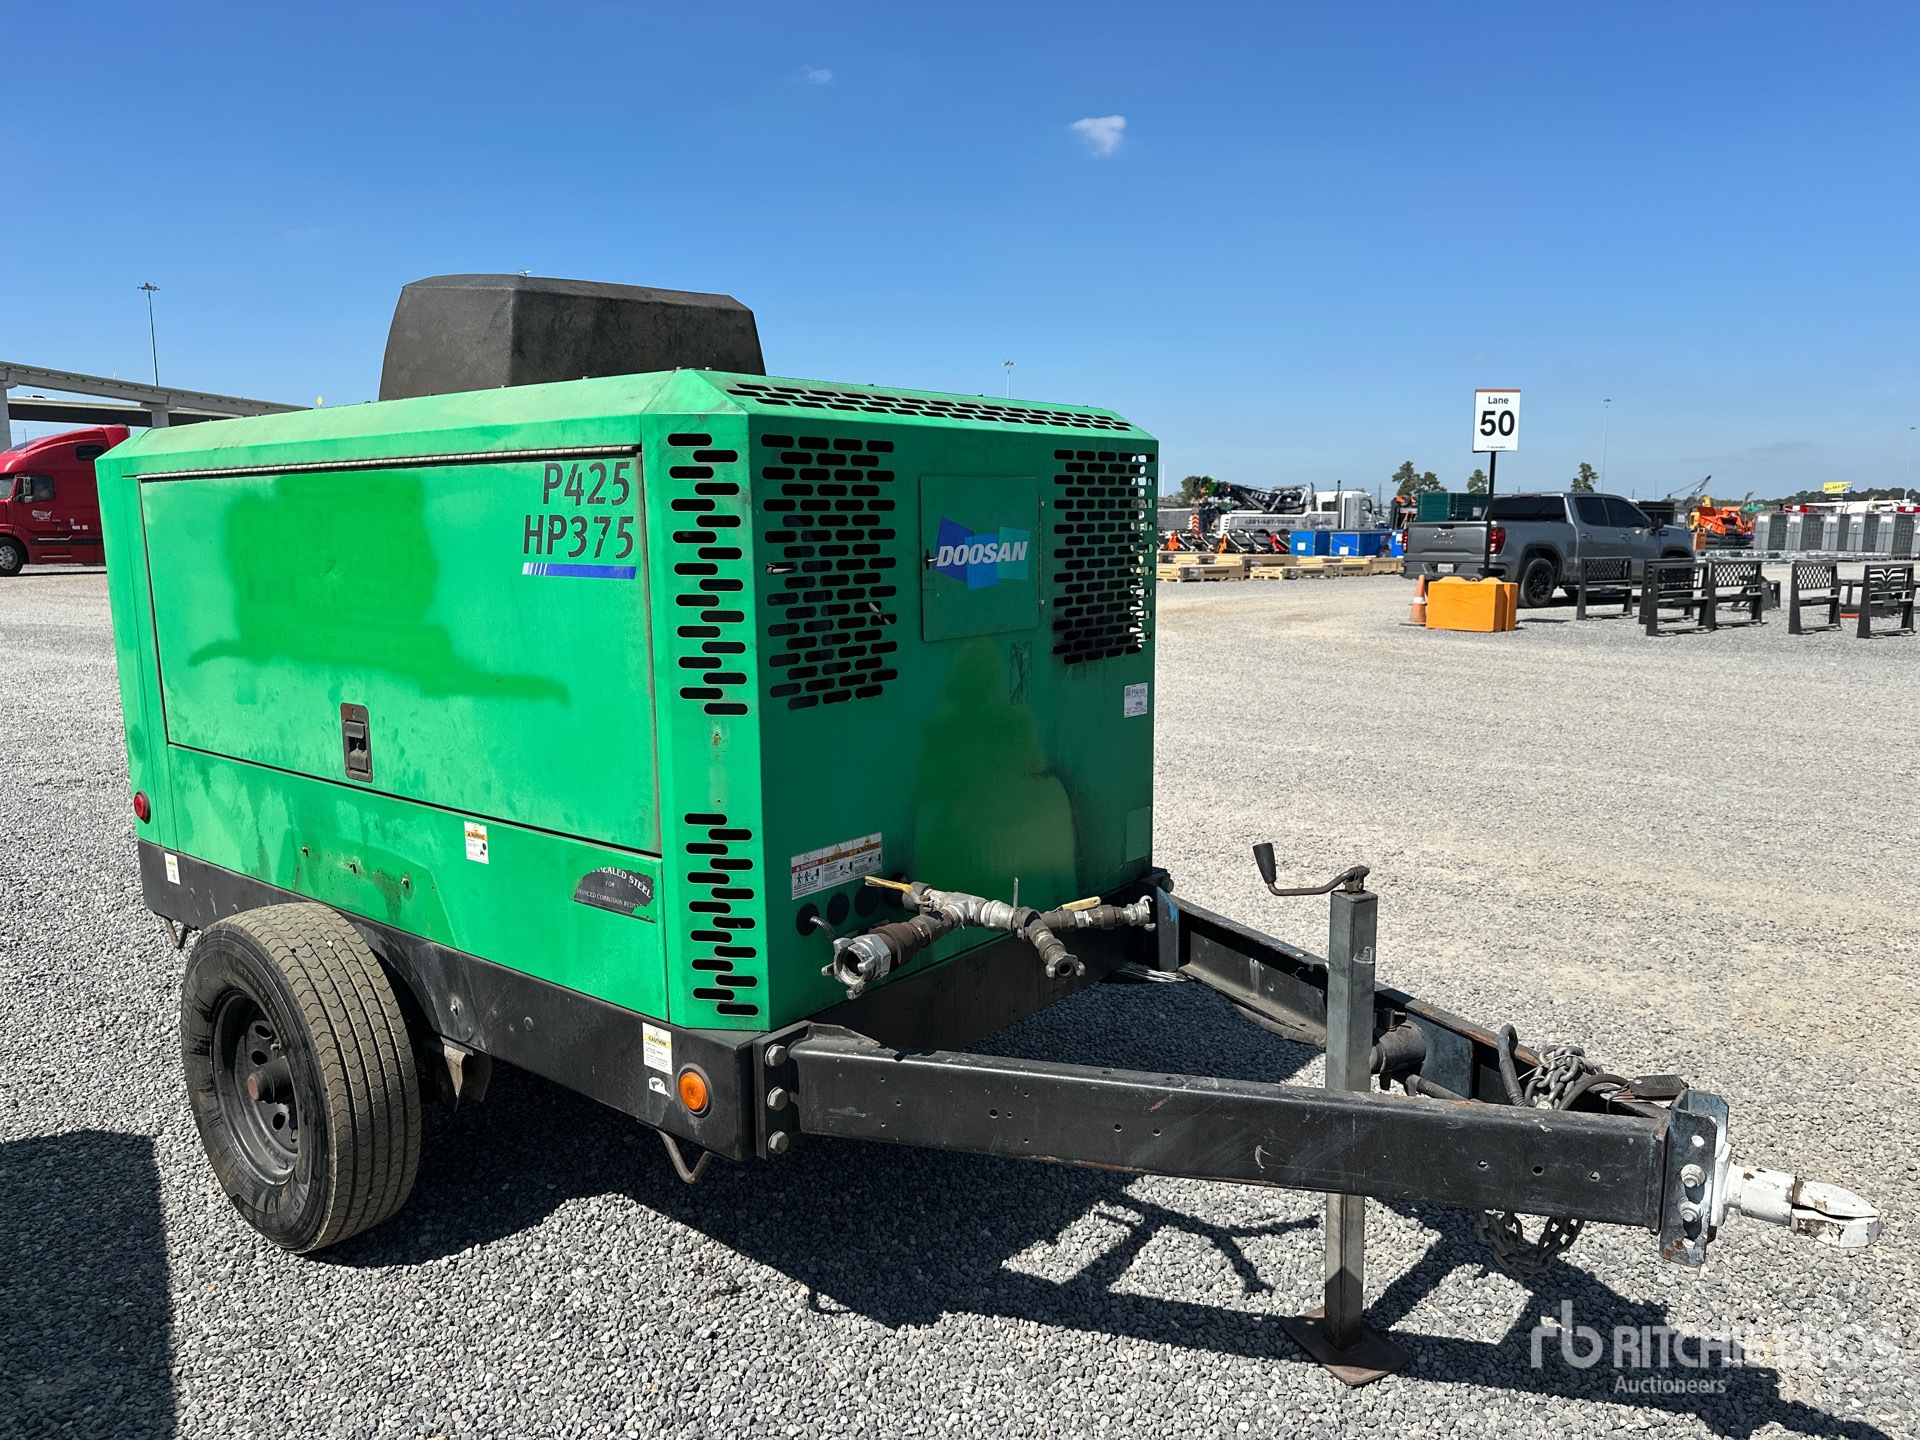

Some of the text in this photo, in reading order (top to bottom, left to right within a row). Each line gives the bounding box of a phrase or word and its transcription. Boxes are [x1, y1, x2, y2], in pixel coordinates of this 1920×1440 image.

[1488, 396, 1509, 404] Lane
[1480, 410, 1515, 436] 50
[543, 461, 631, 506] P425
[1249, 490, 1271, 501] HTS
[523, 514, 635, 559] HP375
[936, 541, 1028, 567] DOOSAN
[605, 880, 615, 888] FOR
[628, 875, 652, 899] STEEL
[648, 1035, 667, 1048] CAUTION
